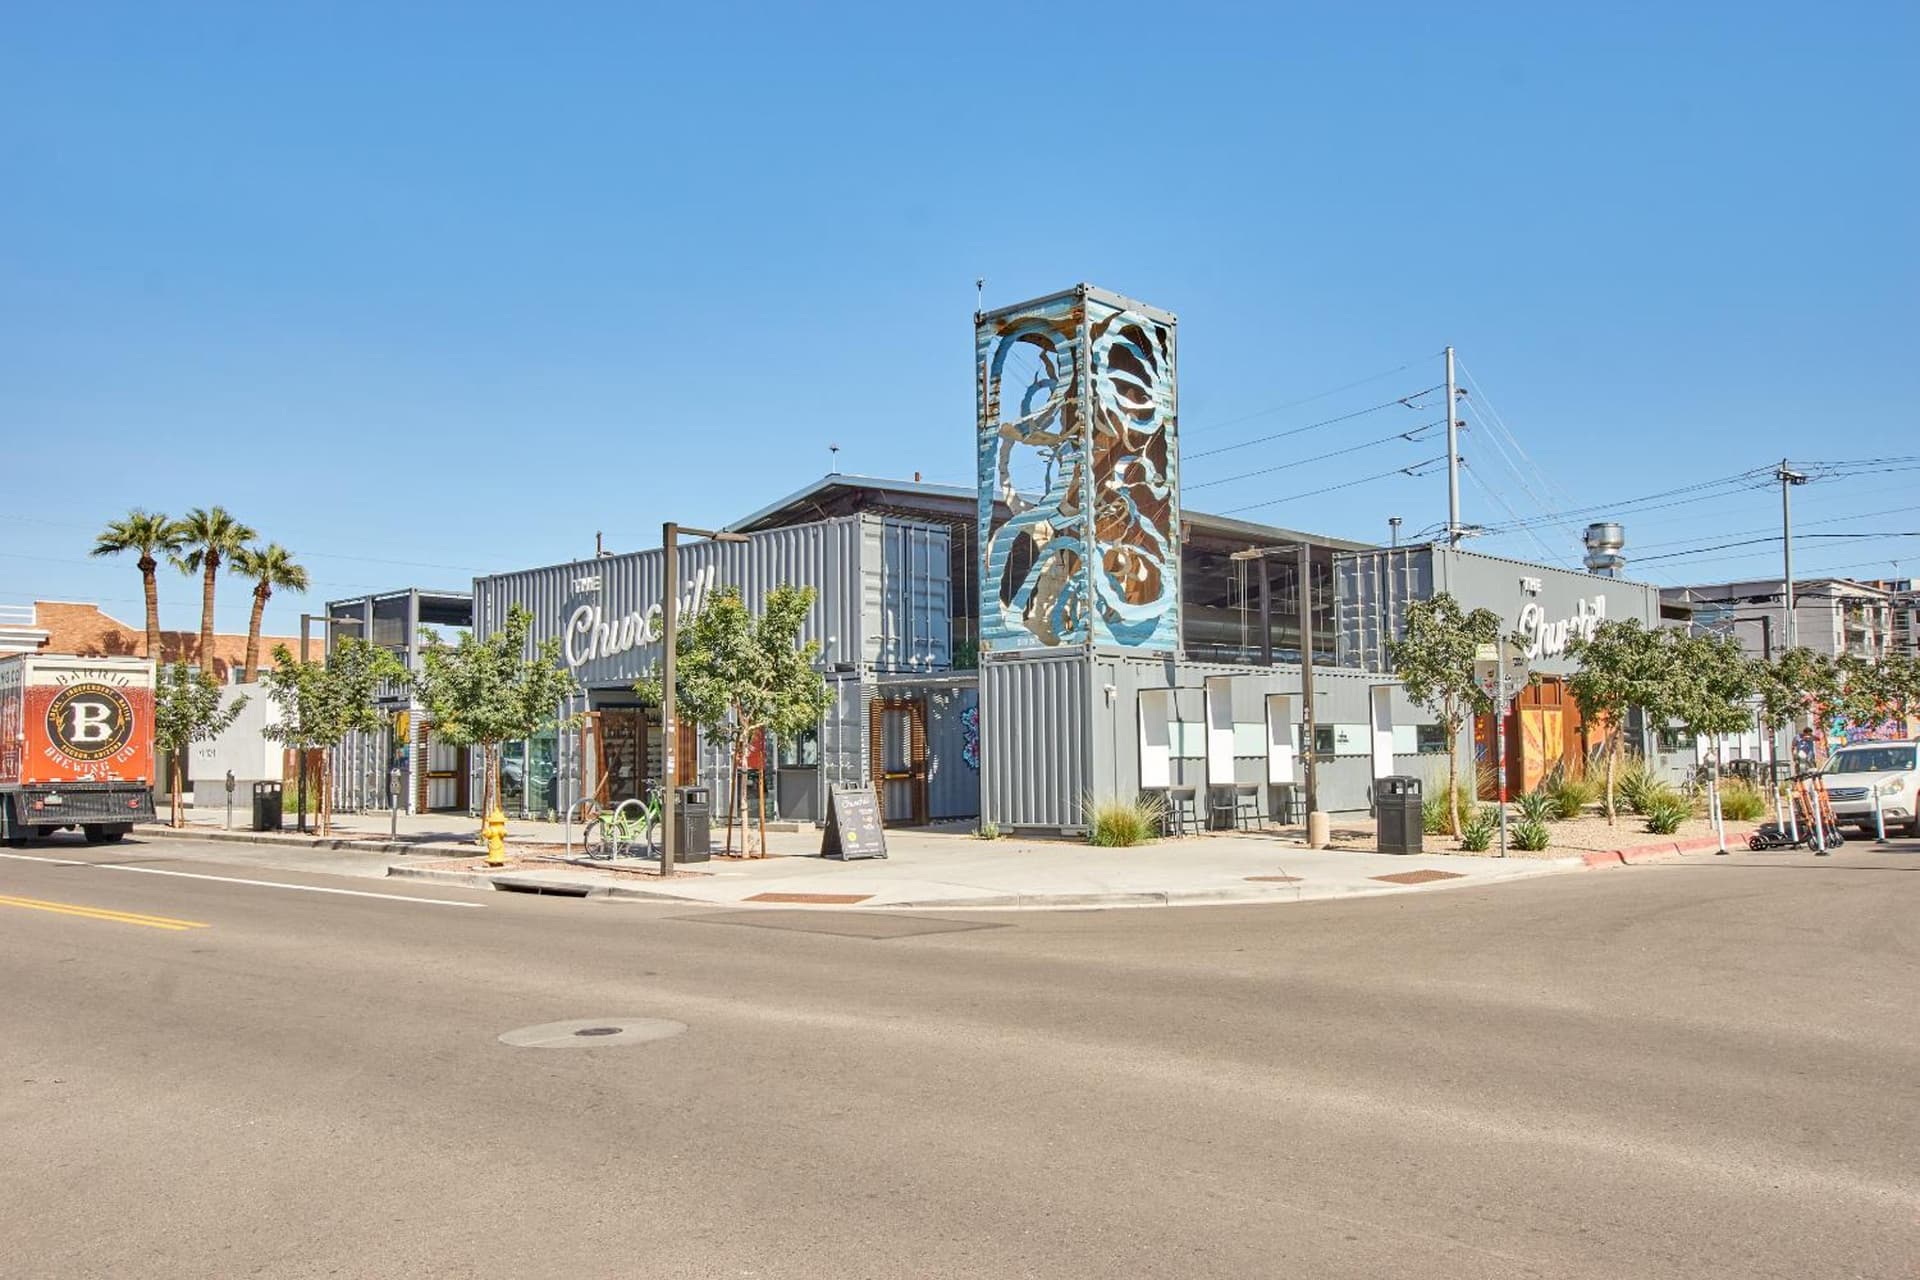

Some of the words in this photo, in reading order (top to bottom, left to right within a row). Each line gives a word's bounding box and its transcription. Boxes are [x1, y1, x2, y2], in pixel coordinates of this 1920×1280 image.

[573, 576, 601, 593] THE
[1523, 577, 1543, 592] THE
[55, 668, 130, 688] BARRIO
[49, 698, 62, 721] LOCAL
[65, 683, 115, 698] INDEPENDENT
[118, 698, 132, 722] NATIVE
[69, 702, 113, 742] B
[44, 745, 111, 773] BREWING
[93, 741, 123, 760] ARIZONA
